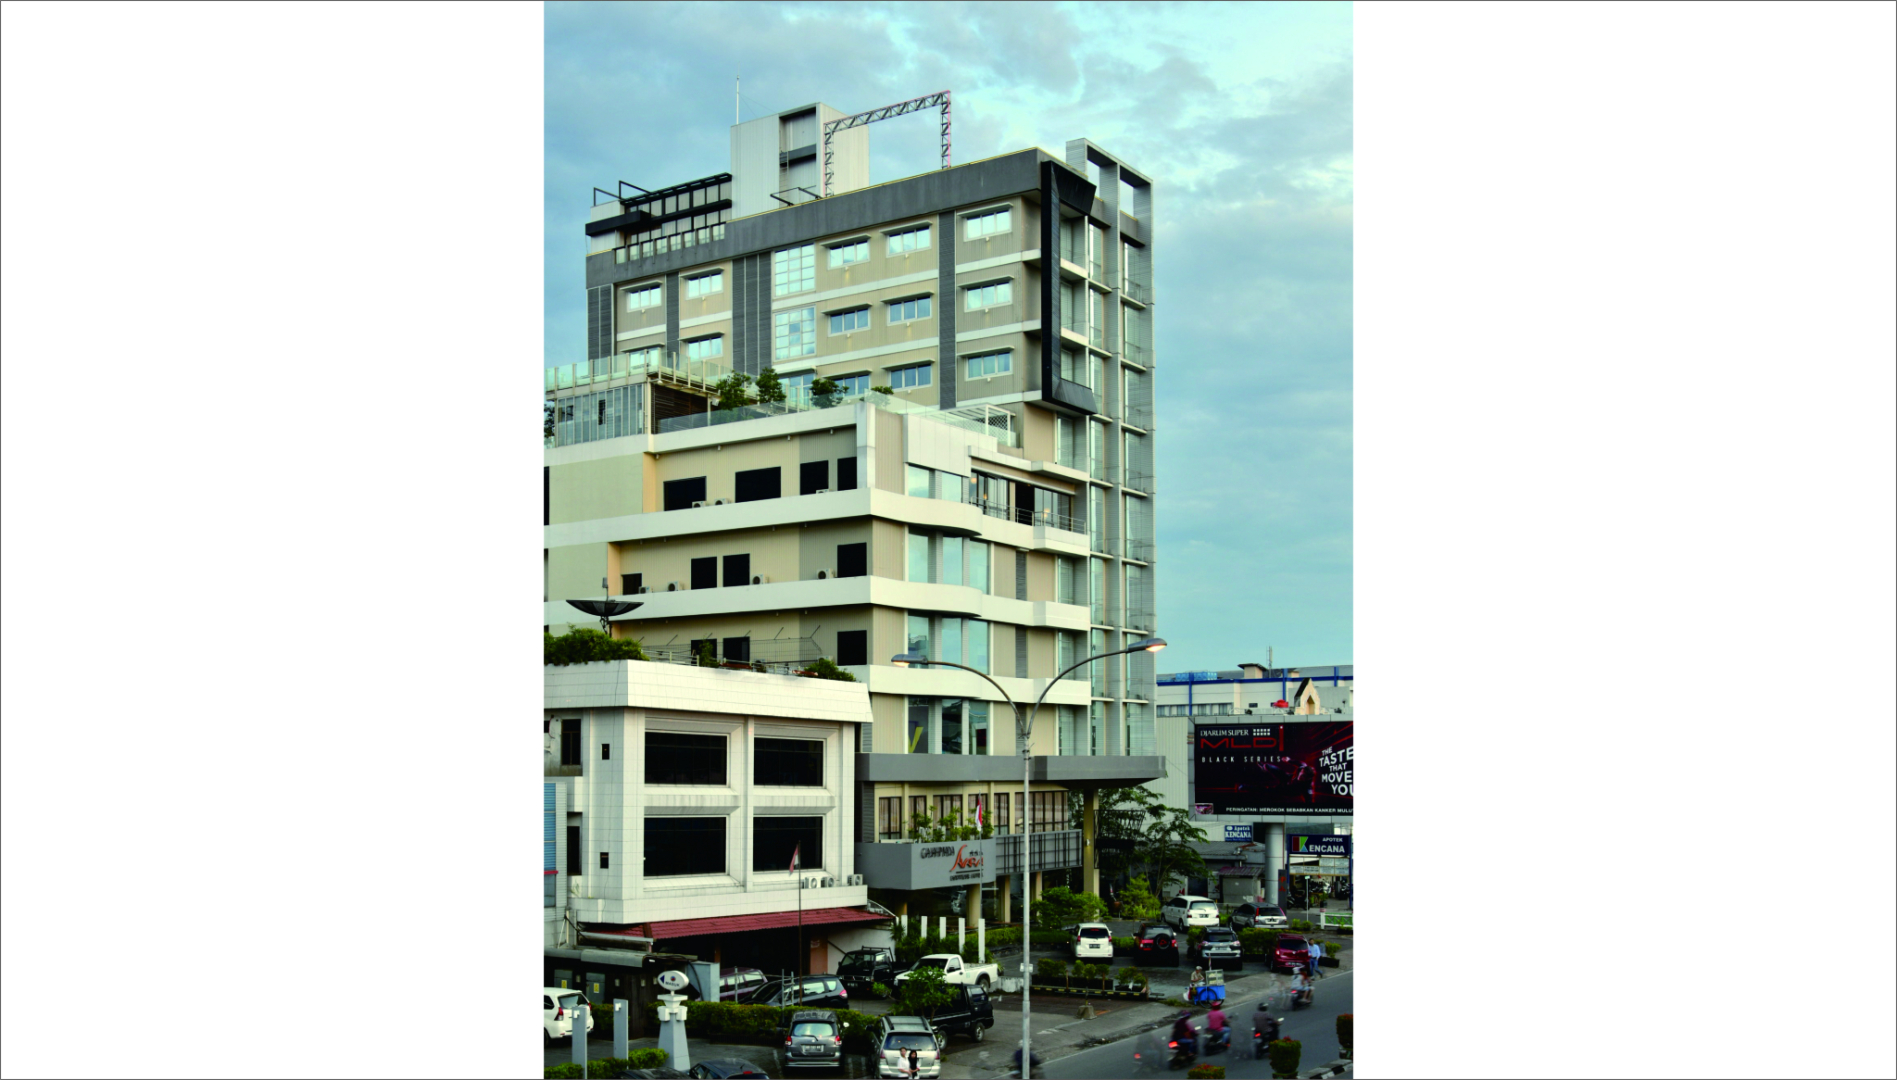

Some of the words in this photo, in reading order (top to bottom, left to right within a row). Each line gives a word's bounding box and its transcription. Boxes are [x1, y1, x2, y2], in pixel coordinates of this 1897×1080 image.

[1200, 729, 1227, 737] DJARUM
[1228, 729, 1249, 737] SUPER
[1321, 746, 1333, 756] THE
[1319, 746, 1353, 767] TASTE
[1329, 762, 1347, 771] THAT
[1321, 771, 1353, 783] MOVE
